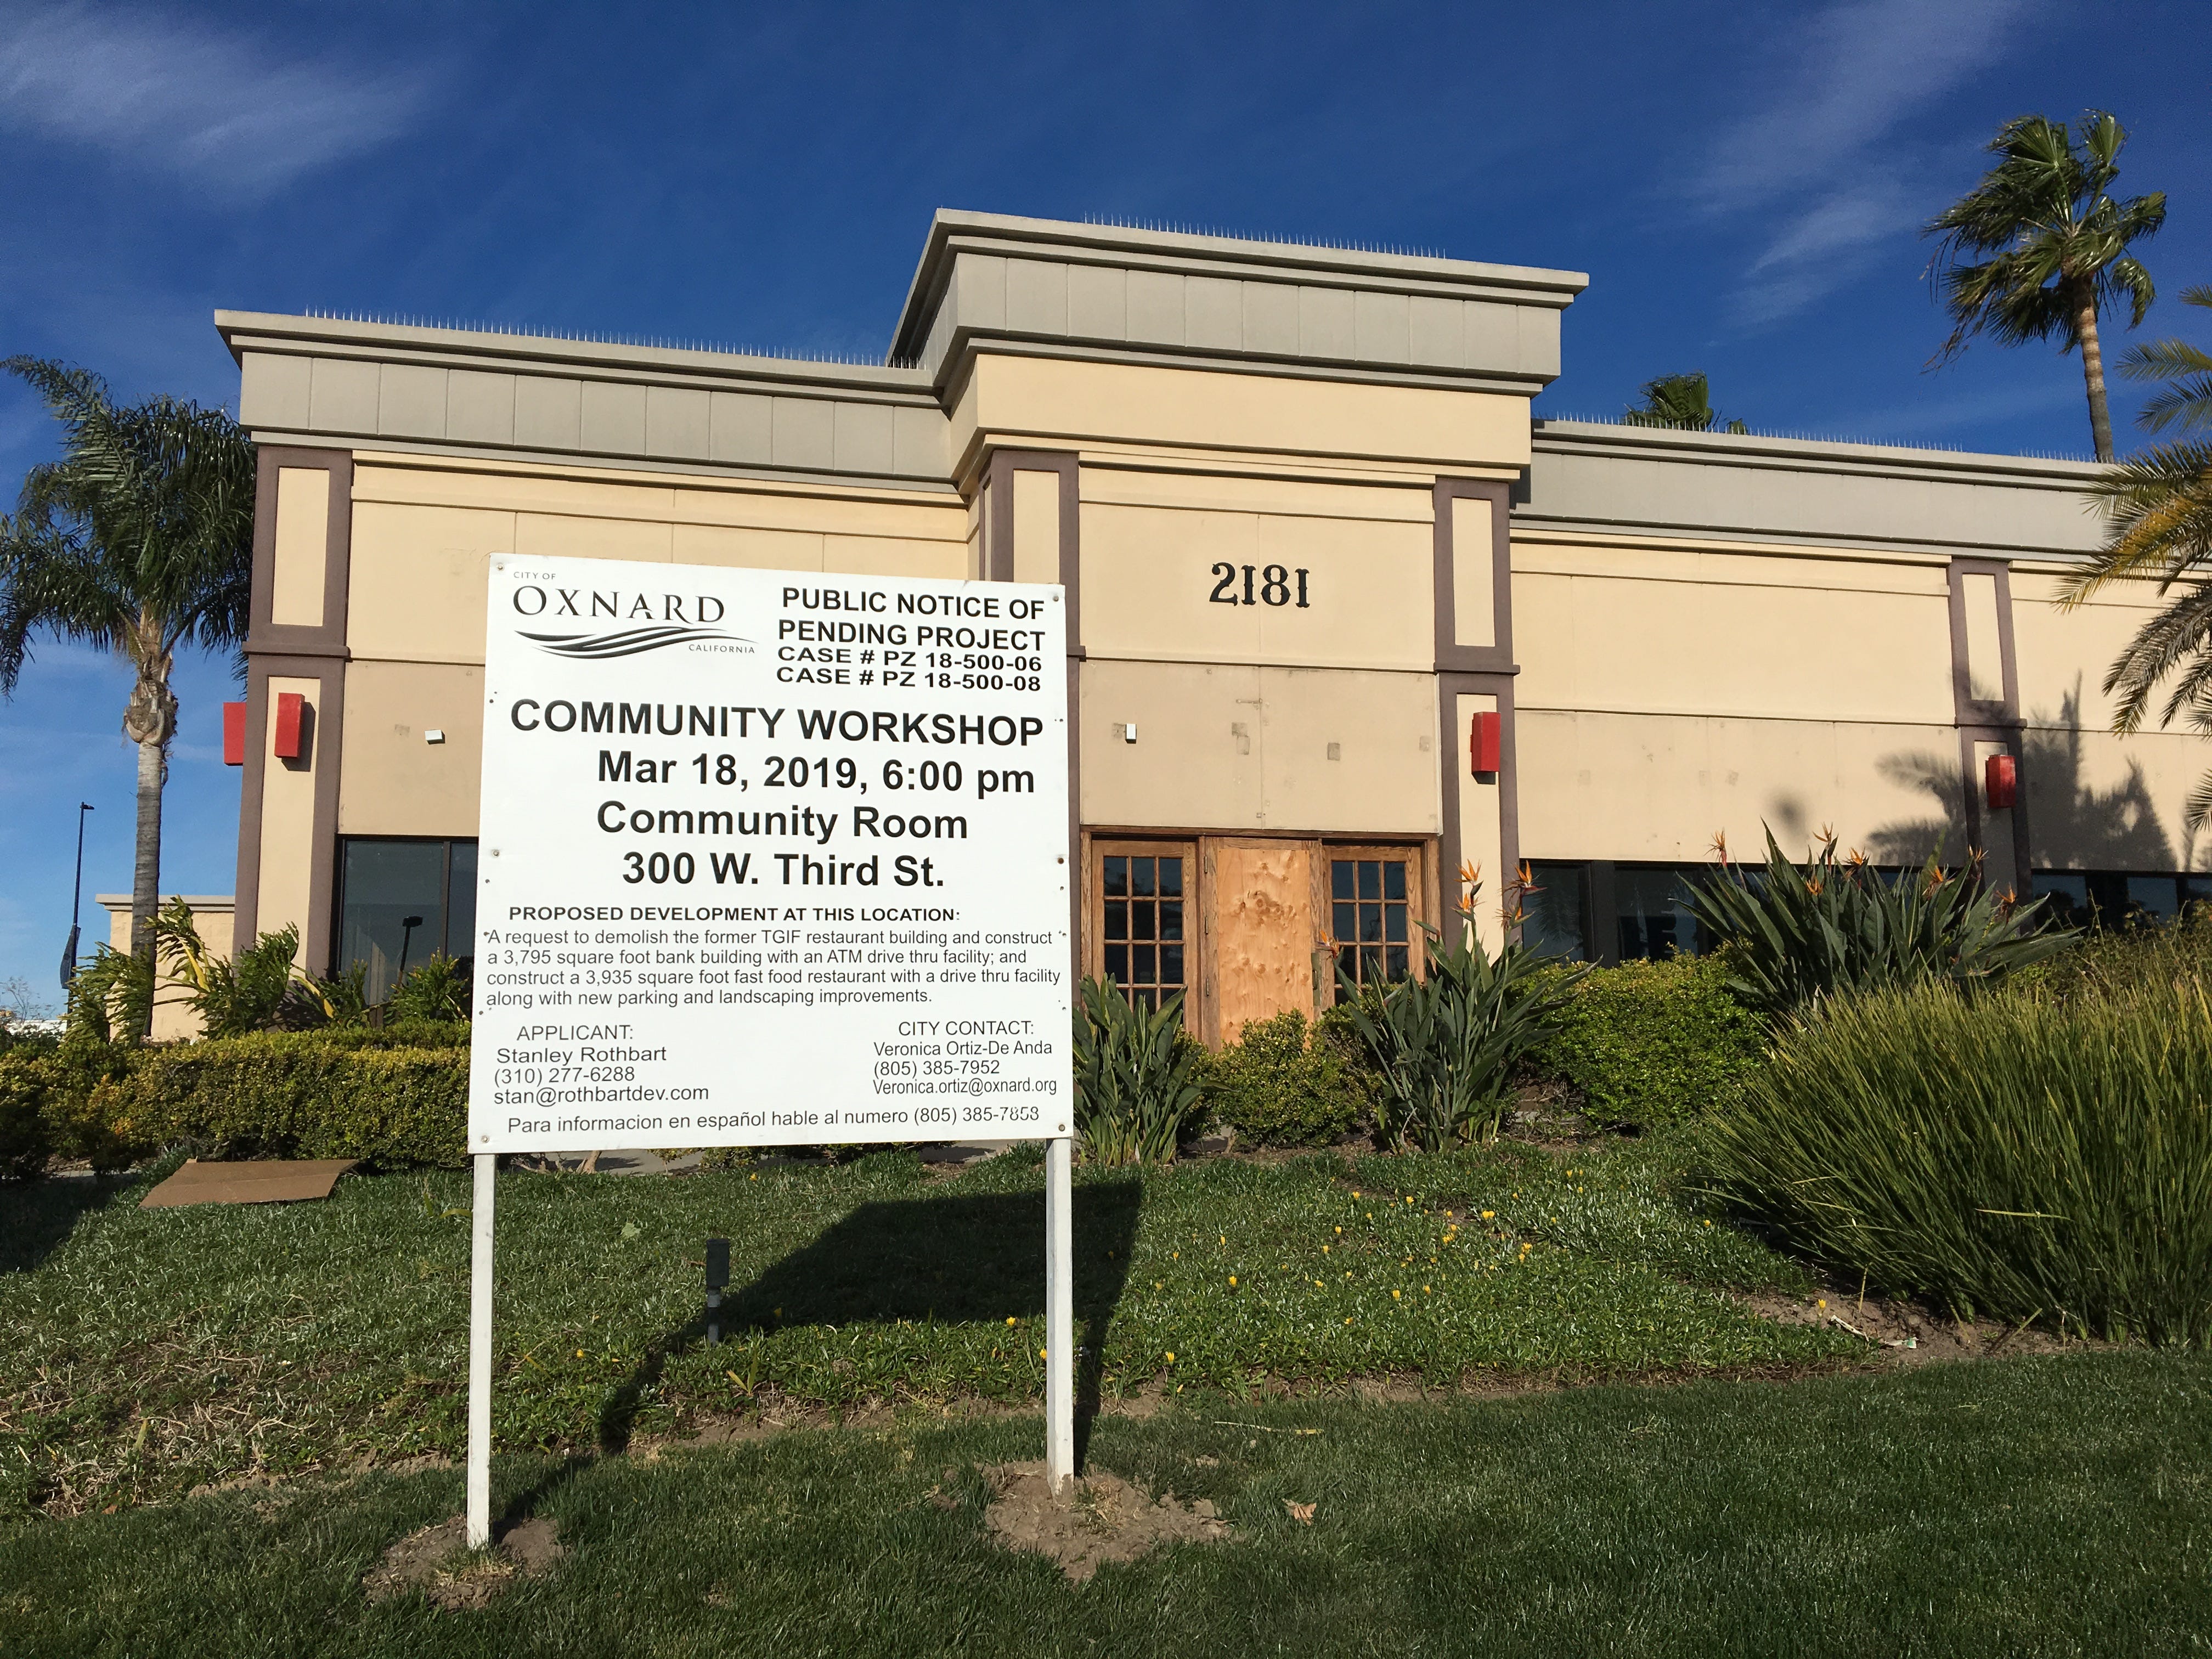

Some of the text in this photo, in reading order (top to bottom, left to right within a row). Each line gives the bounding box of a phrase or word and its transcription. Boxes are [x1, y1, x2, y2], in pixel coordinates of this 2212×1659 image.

[1209, 562, 1311, 608] 2181
[513, 585, 725, 624] OXNARD
[783, 587, 1045, 619] PUBLIC NOTICE OF
[779, 619, 1046, 651] PENDING PROJECT
[689, 644, 754, 653] CALIFORNIA
[778, 646, 1042, 672] CASE # PZ 18-500-06
[776, 667, 1041, 691] CASE # PZ 18-500-08
[511, 699, 1043, 746] COMMUNITY WORKSHOP
[599, 750, 1034, 800] Mar 18, 2019, 6:00 pm
[597, 800, 967, 845] Community Room
[623, 851, 944, 887] 300 W. Third St.
[510, 906, 960, 921] PROPOSED DEVELOPMENT AT THIS LOCATION:
[488, 929, 1052, 947] A request to demolish the former TGIF restaurant building and construct
[488, 949, 1026, 968] a 3,795 square foot bank building with an ATM drive thru facility; and
[487, 968, 1060, 988] construct a 3,935 square foot fast food restaurant with a drive thru facility
[487, 989, 932, 1009] along with new parking and landscaping improvements.
[516, 1025, 633, 1041] APPLICANT:
[899, 1020, 1034, 1036] CITY CONTACT:
[496, 1046, 667, 1066] Stanley Rothbart
[873, 1040, 1052, 1056] Veronica Ortiz-De Anda
[494, 1066, 635, 1087] (310) 277-6288
[874, 1060, 1000, 1079] (805) 385-7952
[494, 1085, 708, 1107] stan@rothbartdev.com
[873, 1077, 1057, 1097] Veronica.ortiz@oxnard.org
[509, 1118, 550, 1133] Para
[558, 1114, 662, 1131] informacion
[669, 1117, 690, 1128] en
[697, 1111, 765, 1131] español
[772, 1110, 818, 1126] hable
[825, 1109, 838, 1124] al
[845, 1111, 908, 1124] numero
[914, 1107, 957, 1126] (805)
